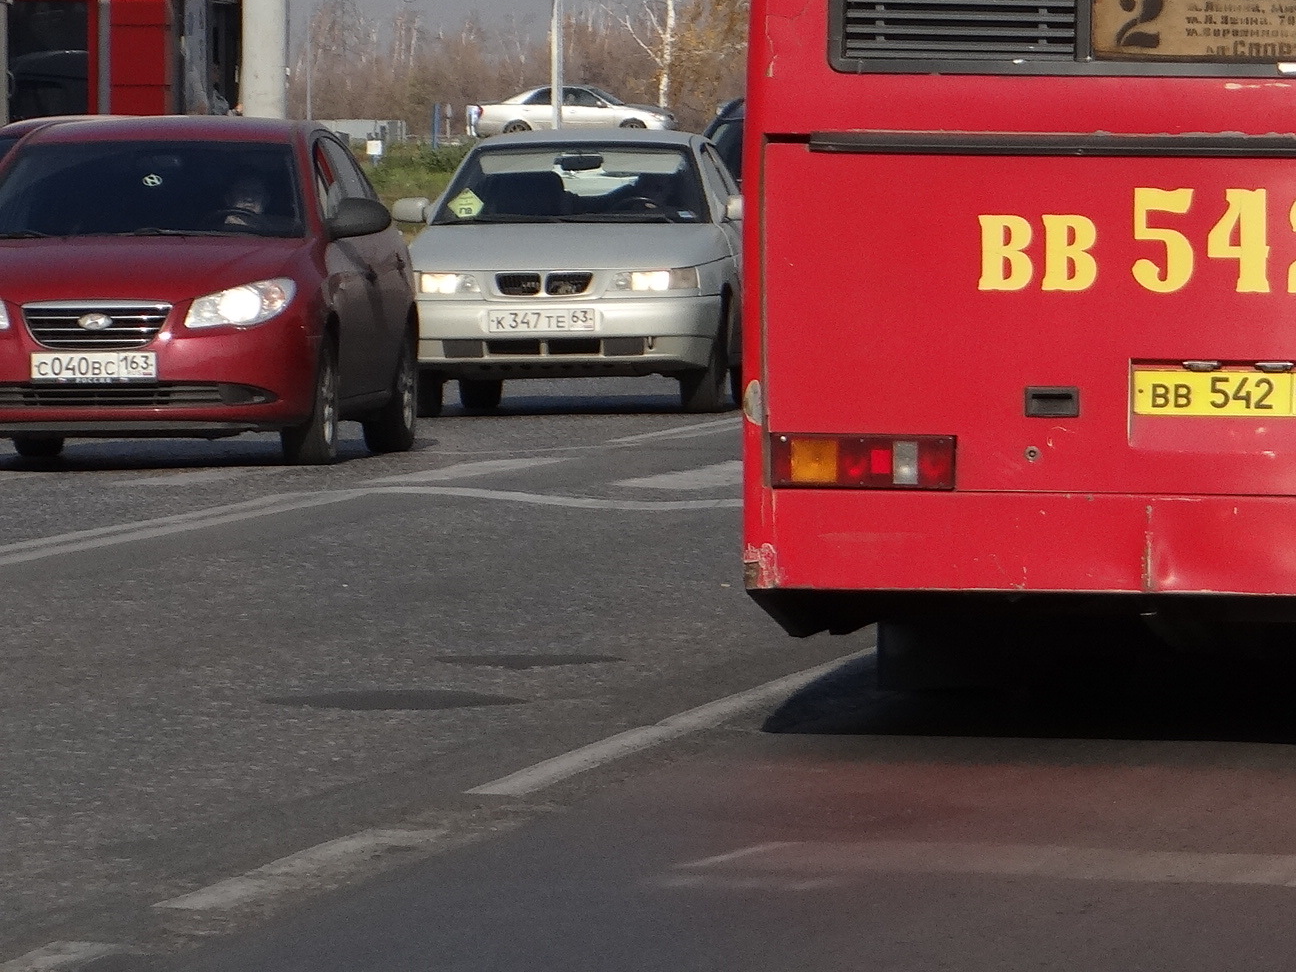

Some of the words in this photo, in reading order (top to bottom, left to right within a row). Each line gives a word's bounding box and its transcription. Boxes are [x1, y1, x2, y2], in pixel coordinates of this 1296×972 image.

[571, 311, 588, 323] 63
[120, 356, 150, 370] 163
[1210, 377, 1274, 410] 542
